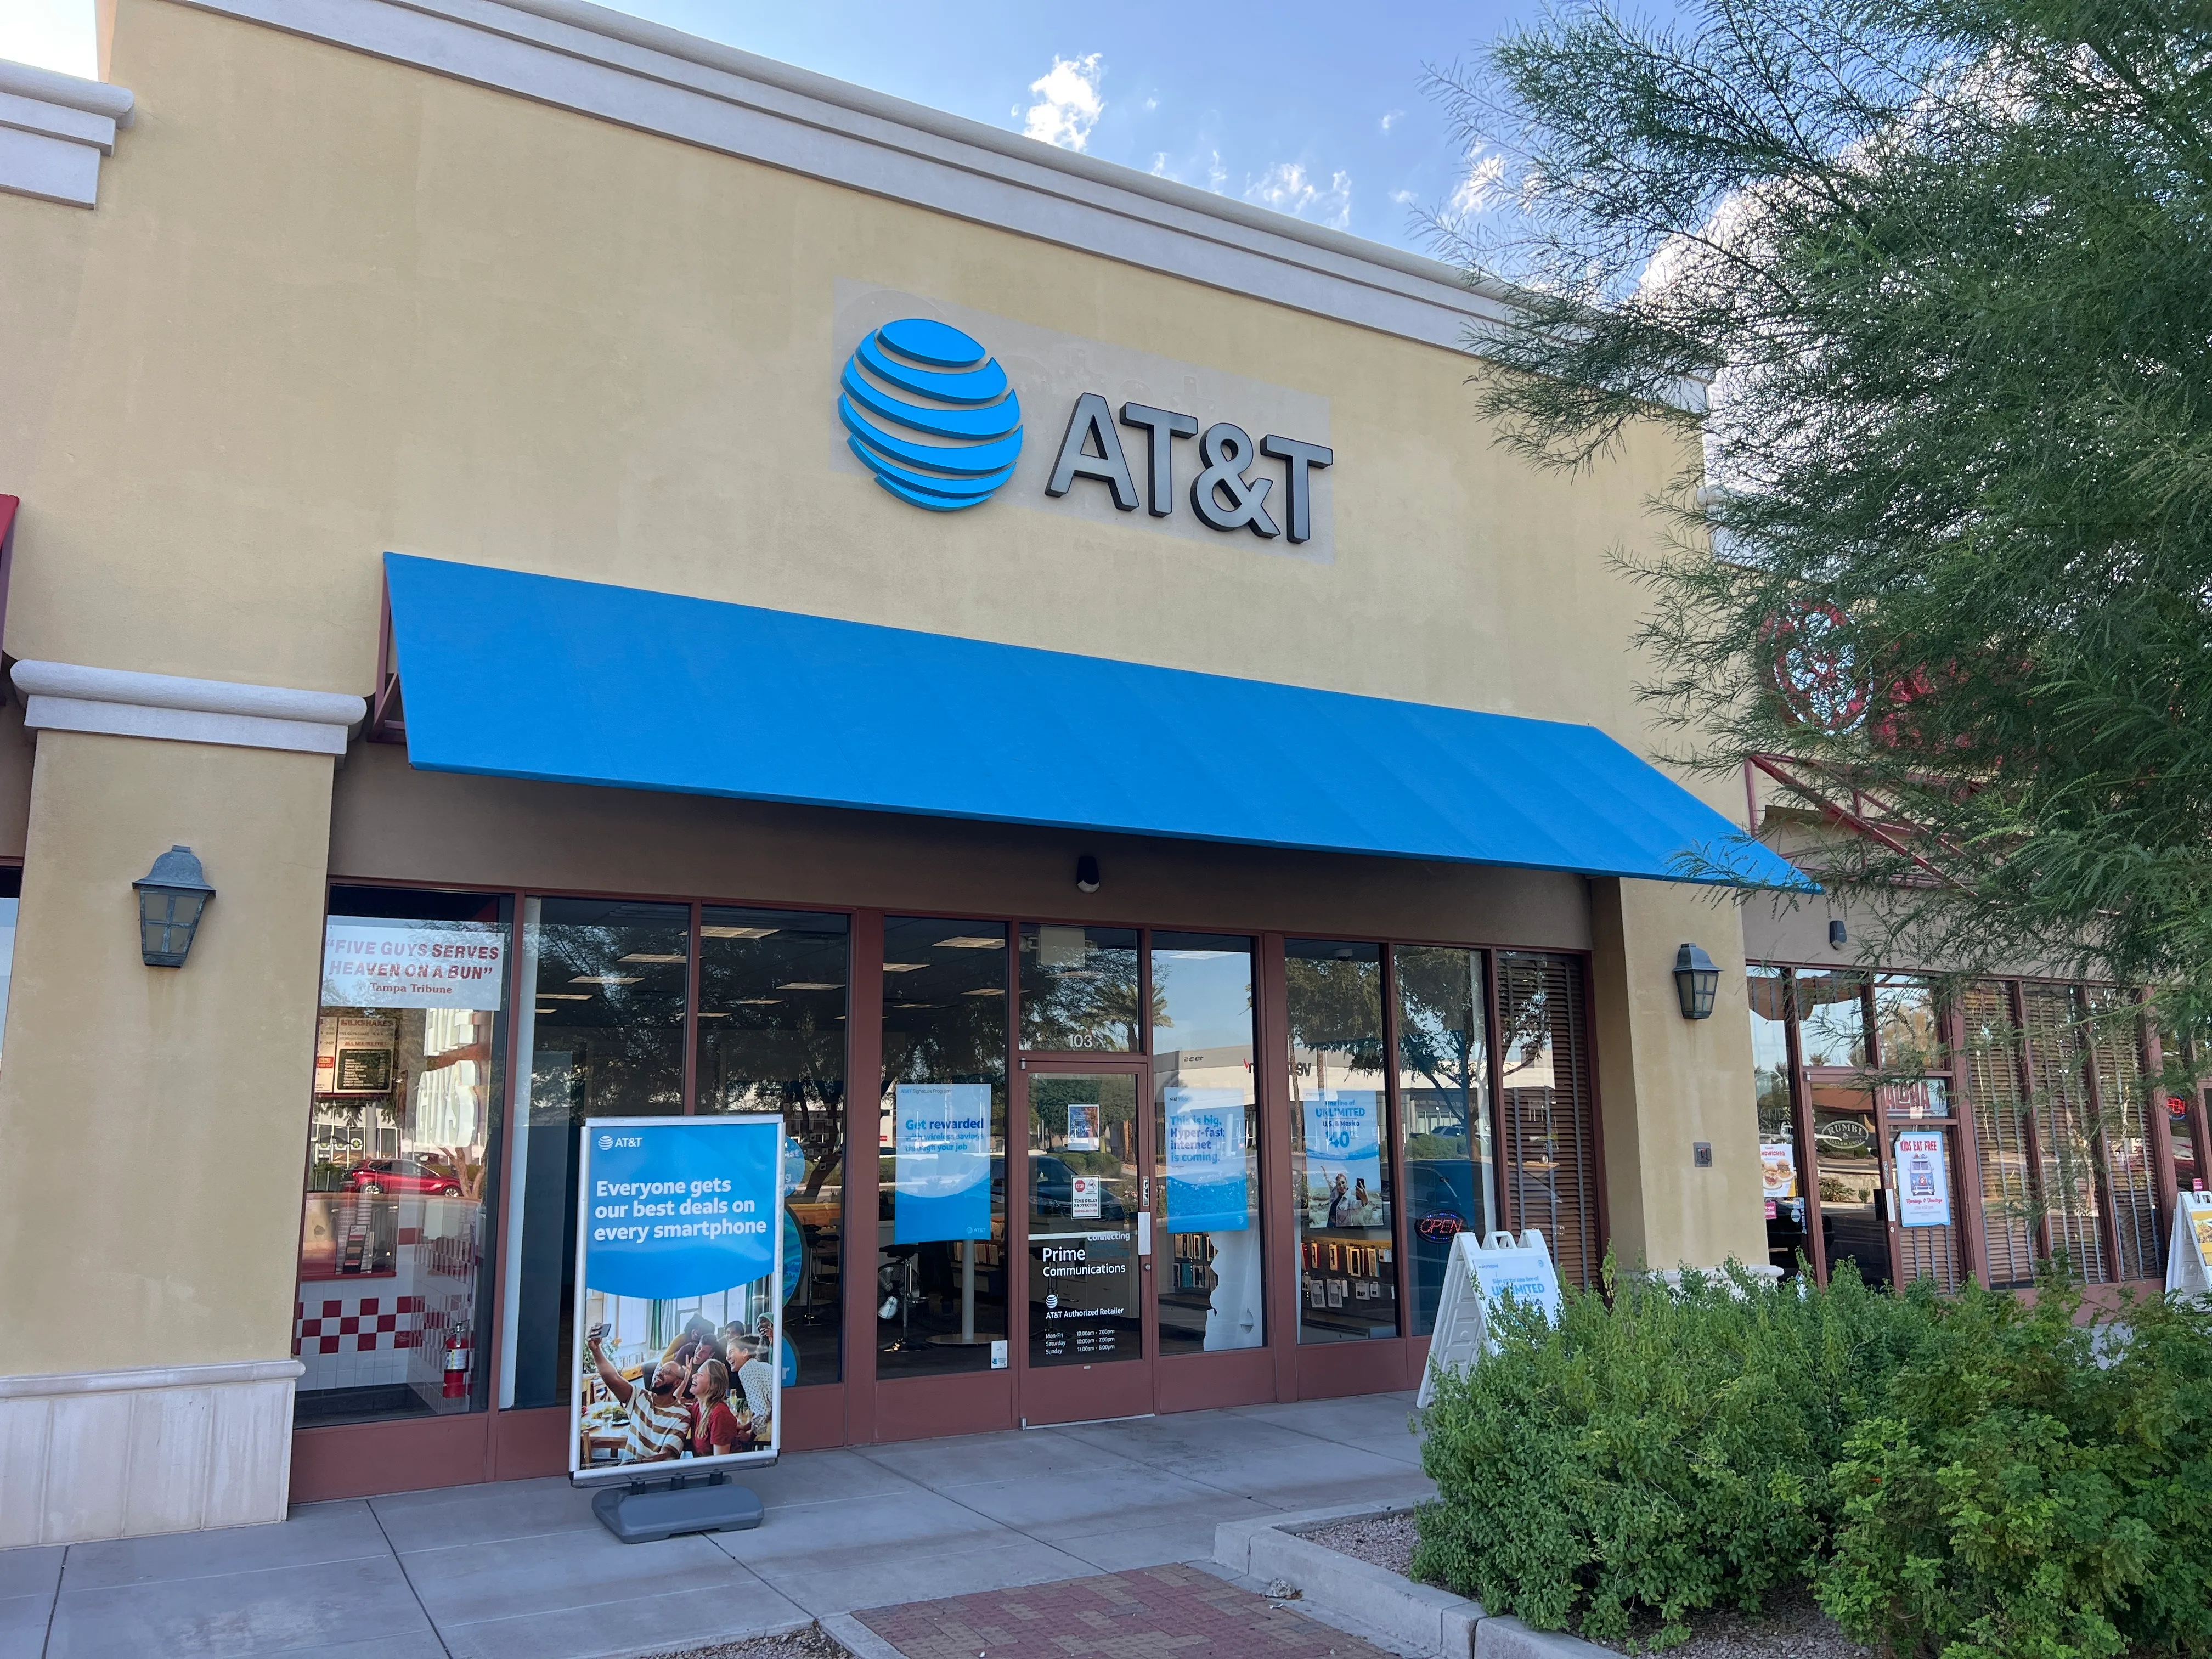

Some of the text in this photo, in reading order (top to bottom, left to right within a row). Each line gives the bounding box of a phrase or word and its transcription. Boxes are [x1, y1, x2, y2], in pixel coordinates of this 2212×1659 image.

[1045, 392, 1333, 544] AT&T
[381, 941, 428, 957] GUYS
[432, 944, 499, 960] SERVES
[329, 960, 400, 977] HEAVEN
[405, 964, 429, 978] ON
[432, 966, 443, 978] A
[370, 983, 452, 994] Tampa Tribune
[1069, 1034, 1092, 1048] 103
[1316, 1108, 1365, 1117] UNLIMITED
[905, 1118, 984, 1130] Get rewarded
[1170, 1115, 1222, 1127] This is big.
[1170, 1127, 1224, 1140] Hyper-fast
[1827, 1124, 1862, 1135] RUMBI
[615, 1137, 642, 1148] AT&T
[924, 1132, 954, 1141] wireless
[957, 1132, 984, 1141] savings
[955, 1143, 967, 1152] job
[1171, 1140, 1211, 1149] internet
[1900, 1140, 1937, 1151] KIDS EAT FREE
[1171, 1151, 1220, 1164] is coming.
[596, 1178, 731, 1199] Everyone gets
[595, 1197, 755, 1218] our best deals on
[594, 1218, 766, 1244] every smartphone
[1420, 1218, 1463, 1233] OPEN
[1043, 1246, 1086, 1262] Prime
[1043, 1263, 1126, 1277] Communications
[1491, 1283, 1545, 1296] UNIMITED
[1064, 1308, 1098, 1318] Authorized
[1099, 1307, 1124, 1316] Retailer
